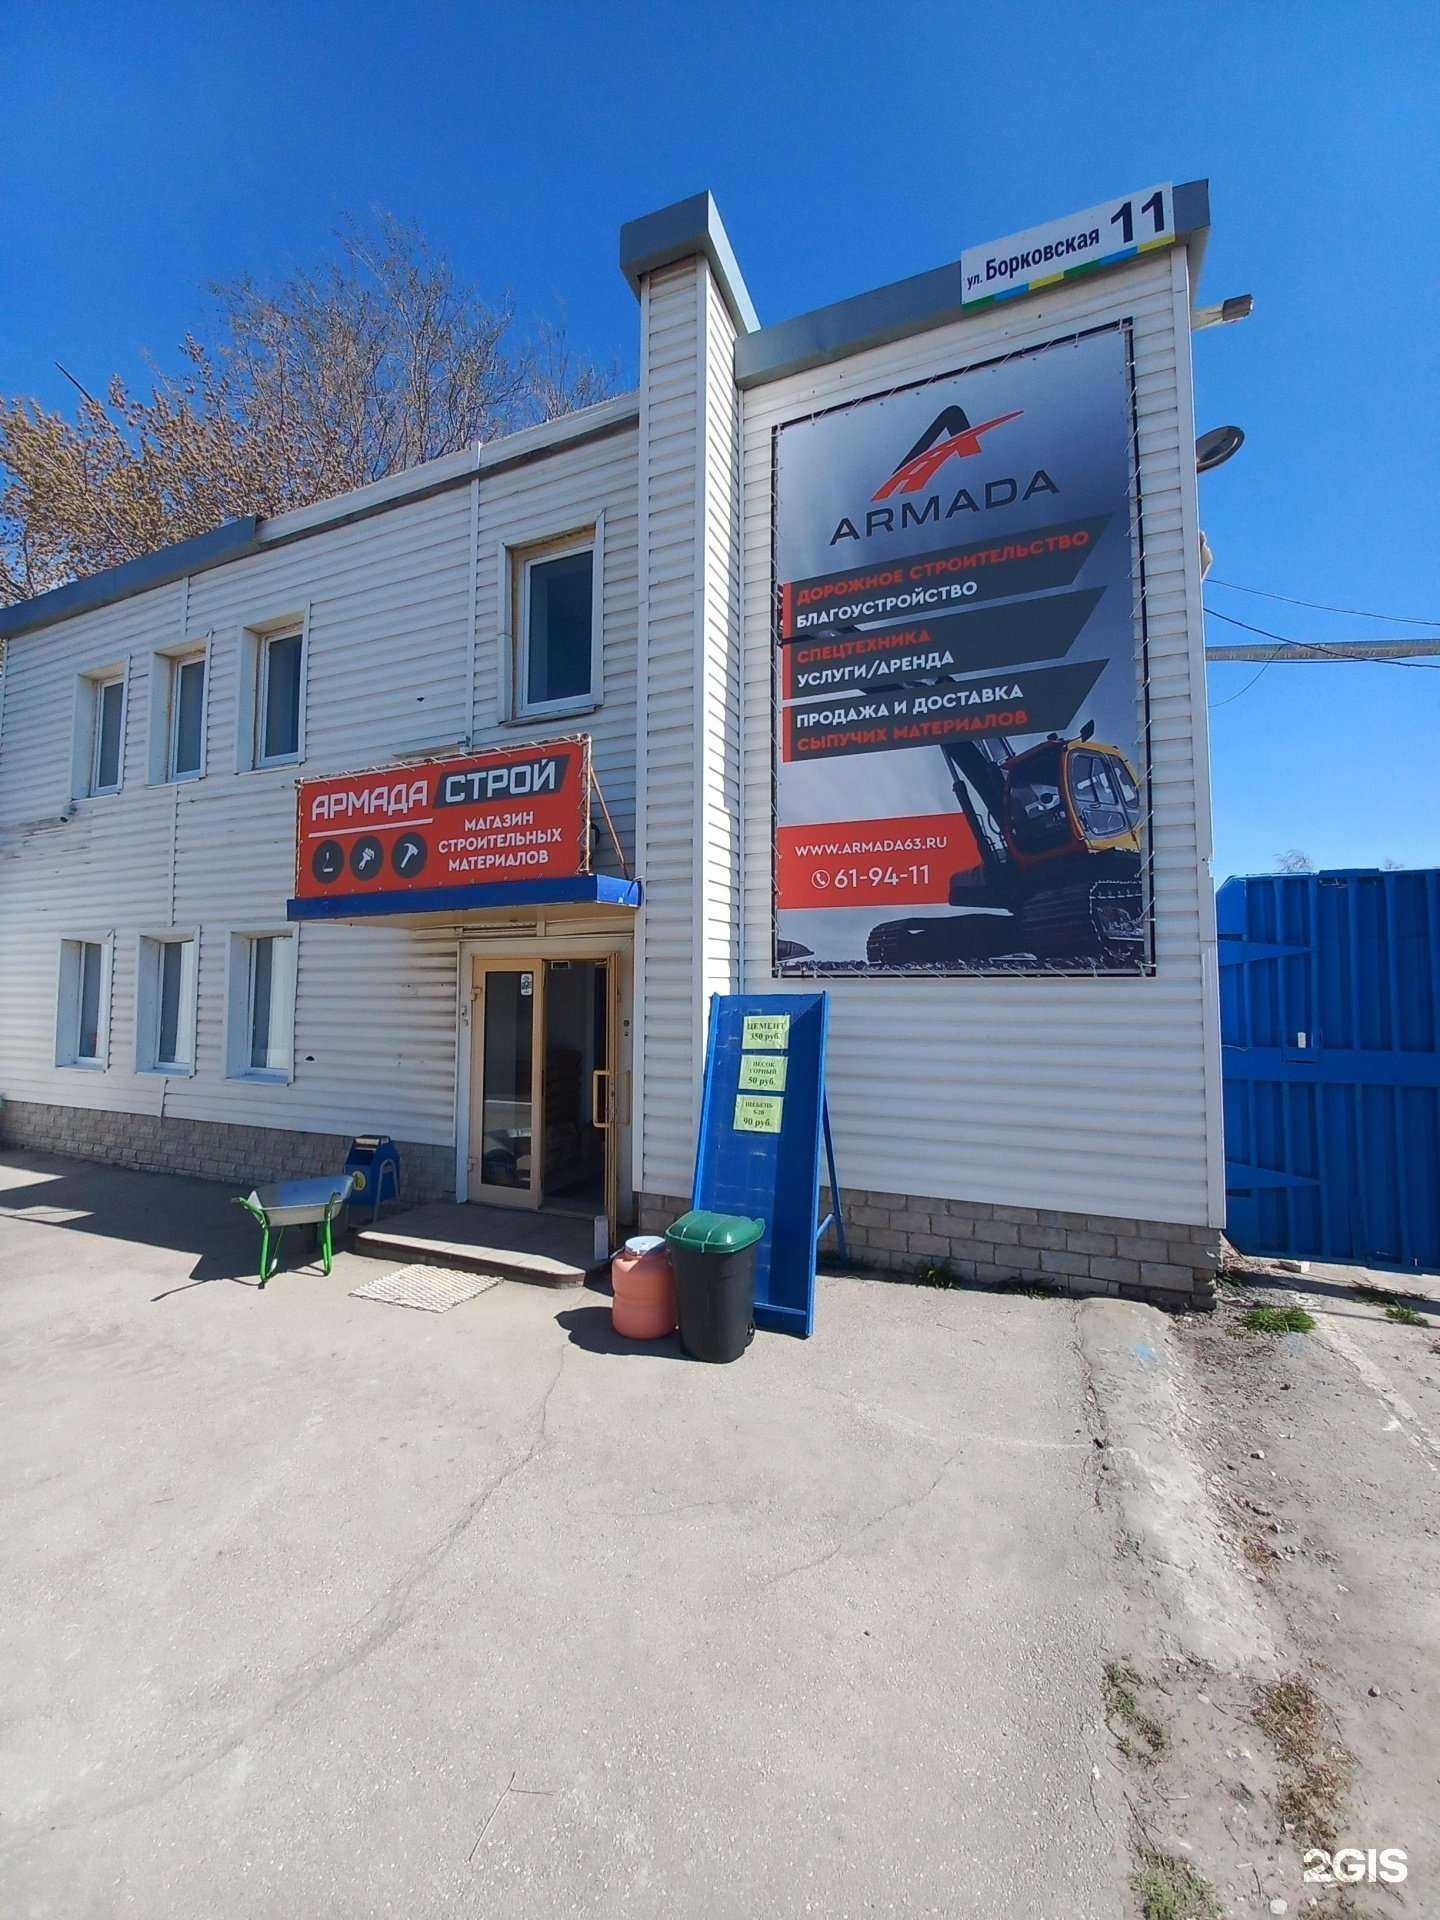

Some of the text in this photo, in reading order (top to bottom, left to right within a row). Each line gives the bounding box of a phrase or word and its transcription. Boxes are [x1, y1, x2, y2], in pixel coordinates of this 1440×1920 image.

[966, 191, 1165, 289] ул. Борковская 11
[830, 470, 1060, 545] ARMADA
[796, 531, 1090, 606] ДОРОЖНОЕ СТРОИТЕЛЬСТВО
[796, 581, 978, 629] БЛАГОУСТРОЙСТВО
[796, 629, 931, 664] СПЕЦТЕХНИКА
[797, 650, 954, 688] УСЛУГИ/АРЕНДА
[796, 684, 1024, 728] ПРОДАЖА И ДОСТАВКА
[797, 711, 1028, 751] СЫПУЧИХ МАТЕРИАЛОВ
[312, 758, 555, 821] АРМАДА СТРОЙ
[438, 828, 562, 854] СТРОИТЕЛЬНЫХ
[465, 811, 533, 832] МАГАЗИН
[449, 852, 549, 872] МАТЕРИАЛОВ
[795, 836, 947, 857] WWW.ARMADA63.RU
[834, 865, 930, 888] 61-94-11
